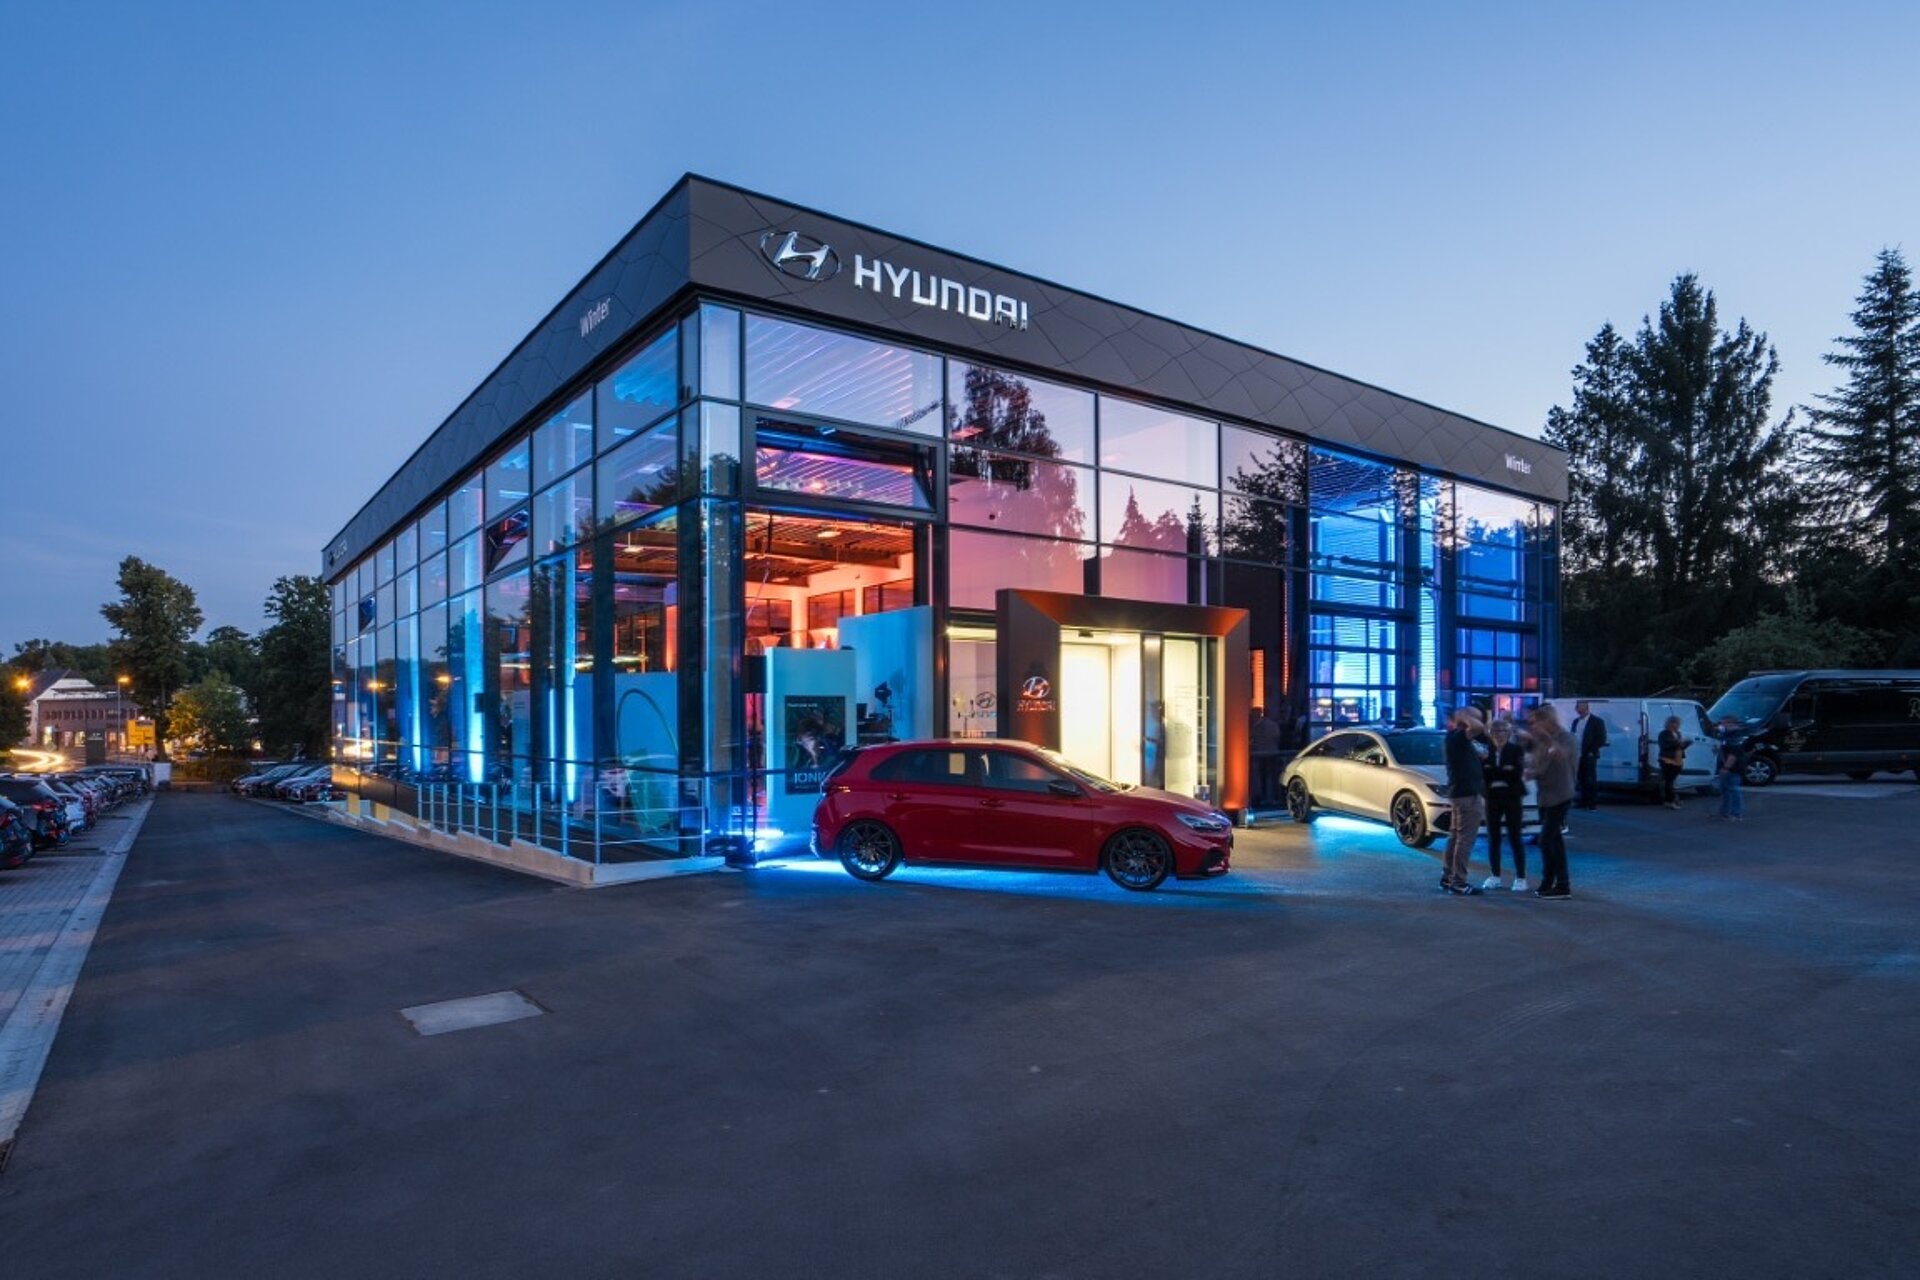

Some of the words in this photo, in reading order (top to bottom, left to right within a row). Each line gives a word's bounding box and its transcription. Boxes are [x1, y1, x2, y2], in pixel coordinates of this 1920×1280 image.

[854, 254, 1028, 331] HYUNDAI
[580, 298, 611, 337] Winter
[1505, 453, 1531, 475] Winter
